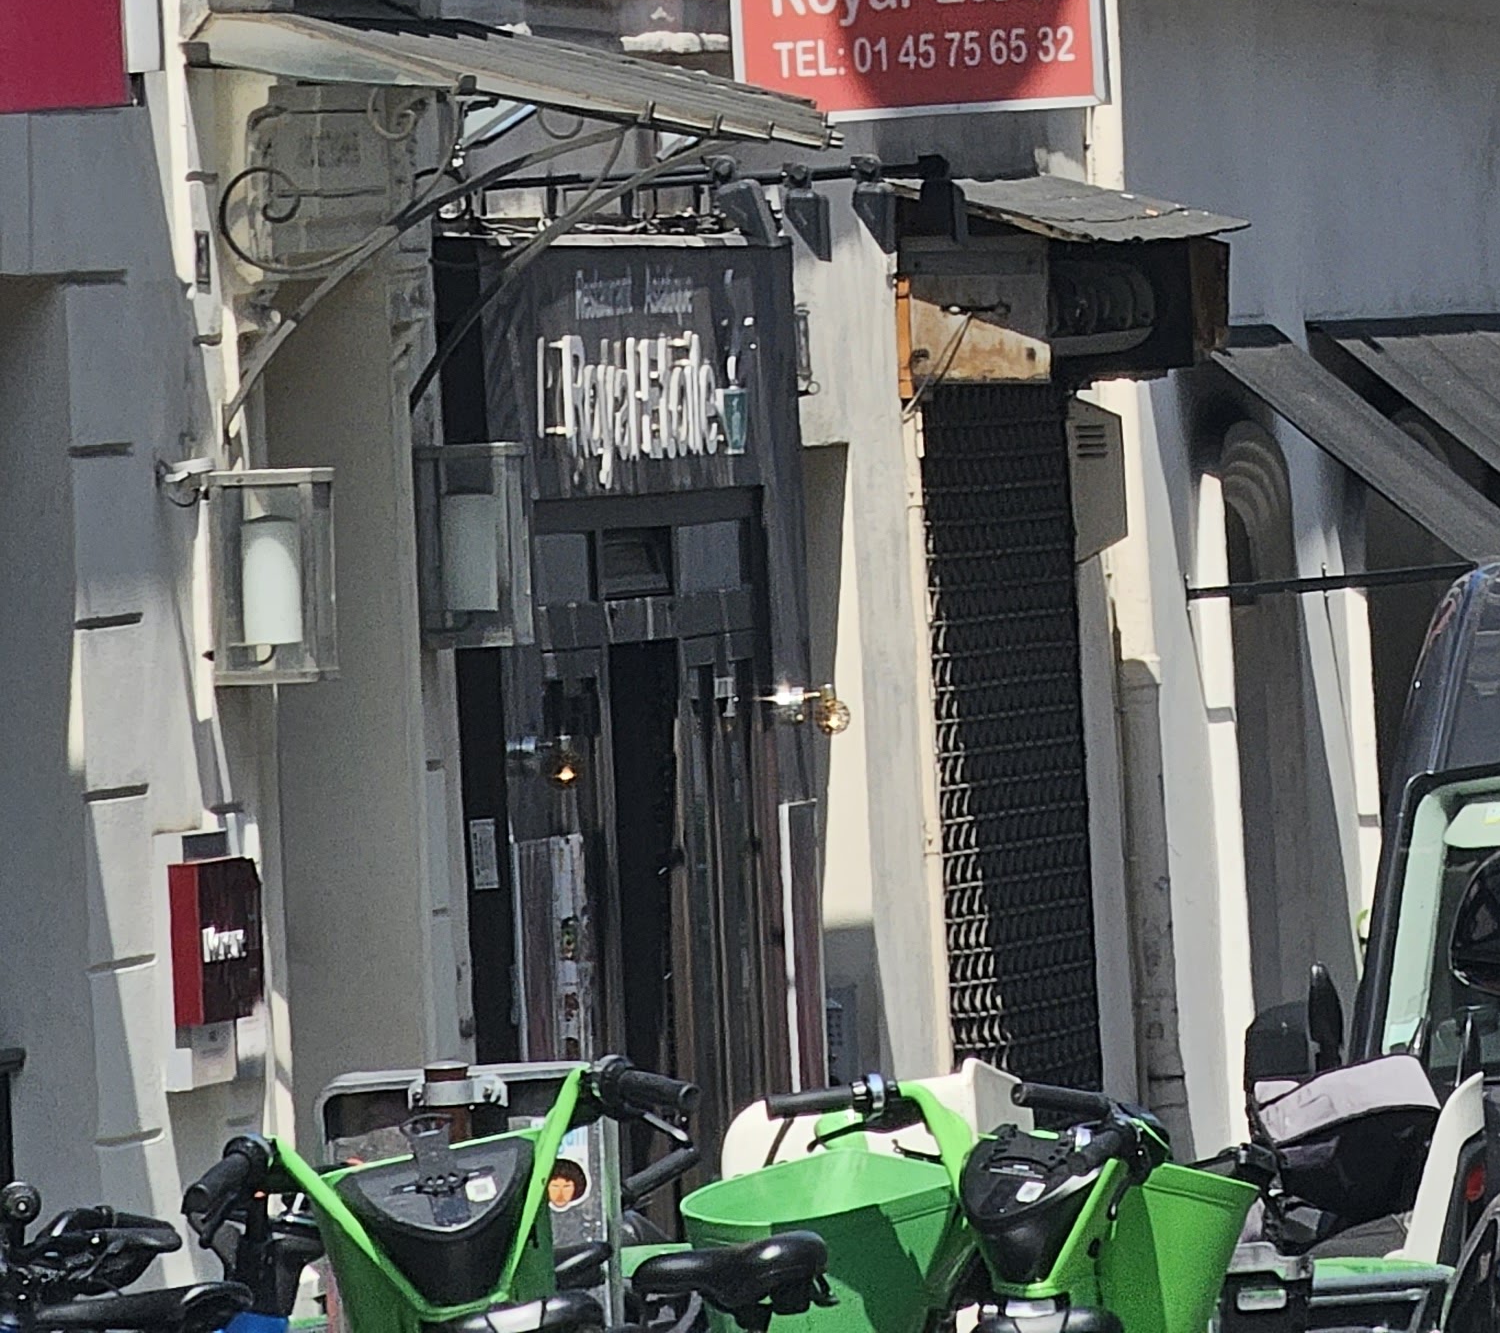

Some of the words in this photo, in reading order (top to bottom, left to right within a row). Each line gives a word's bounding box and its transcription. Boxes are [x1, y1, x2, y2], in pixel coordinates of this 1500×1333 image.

[772, 38, 846, 79] TEL:
[853, 35, 889, 74] 01
[897, 32, 937, 71] 45
[944, 30, 982, 68] 75
[989, 27, 1028, 65] 65
[1037, 25, 1076, 63] 32
